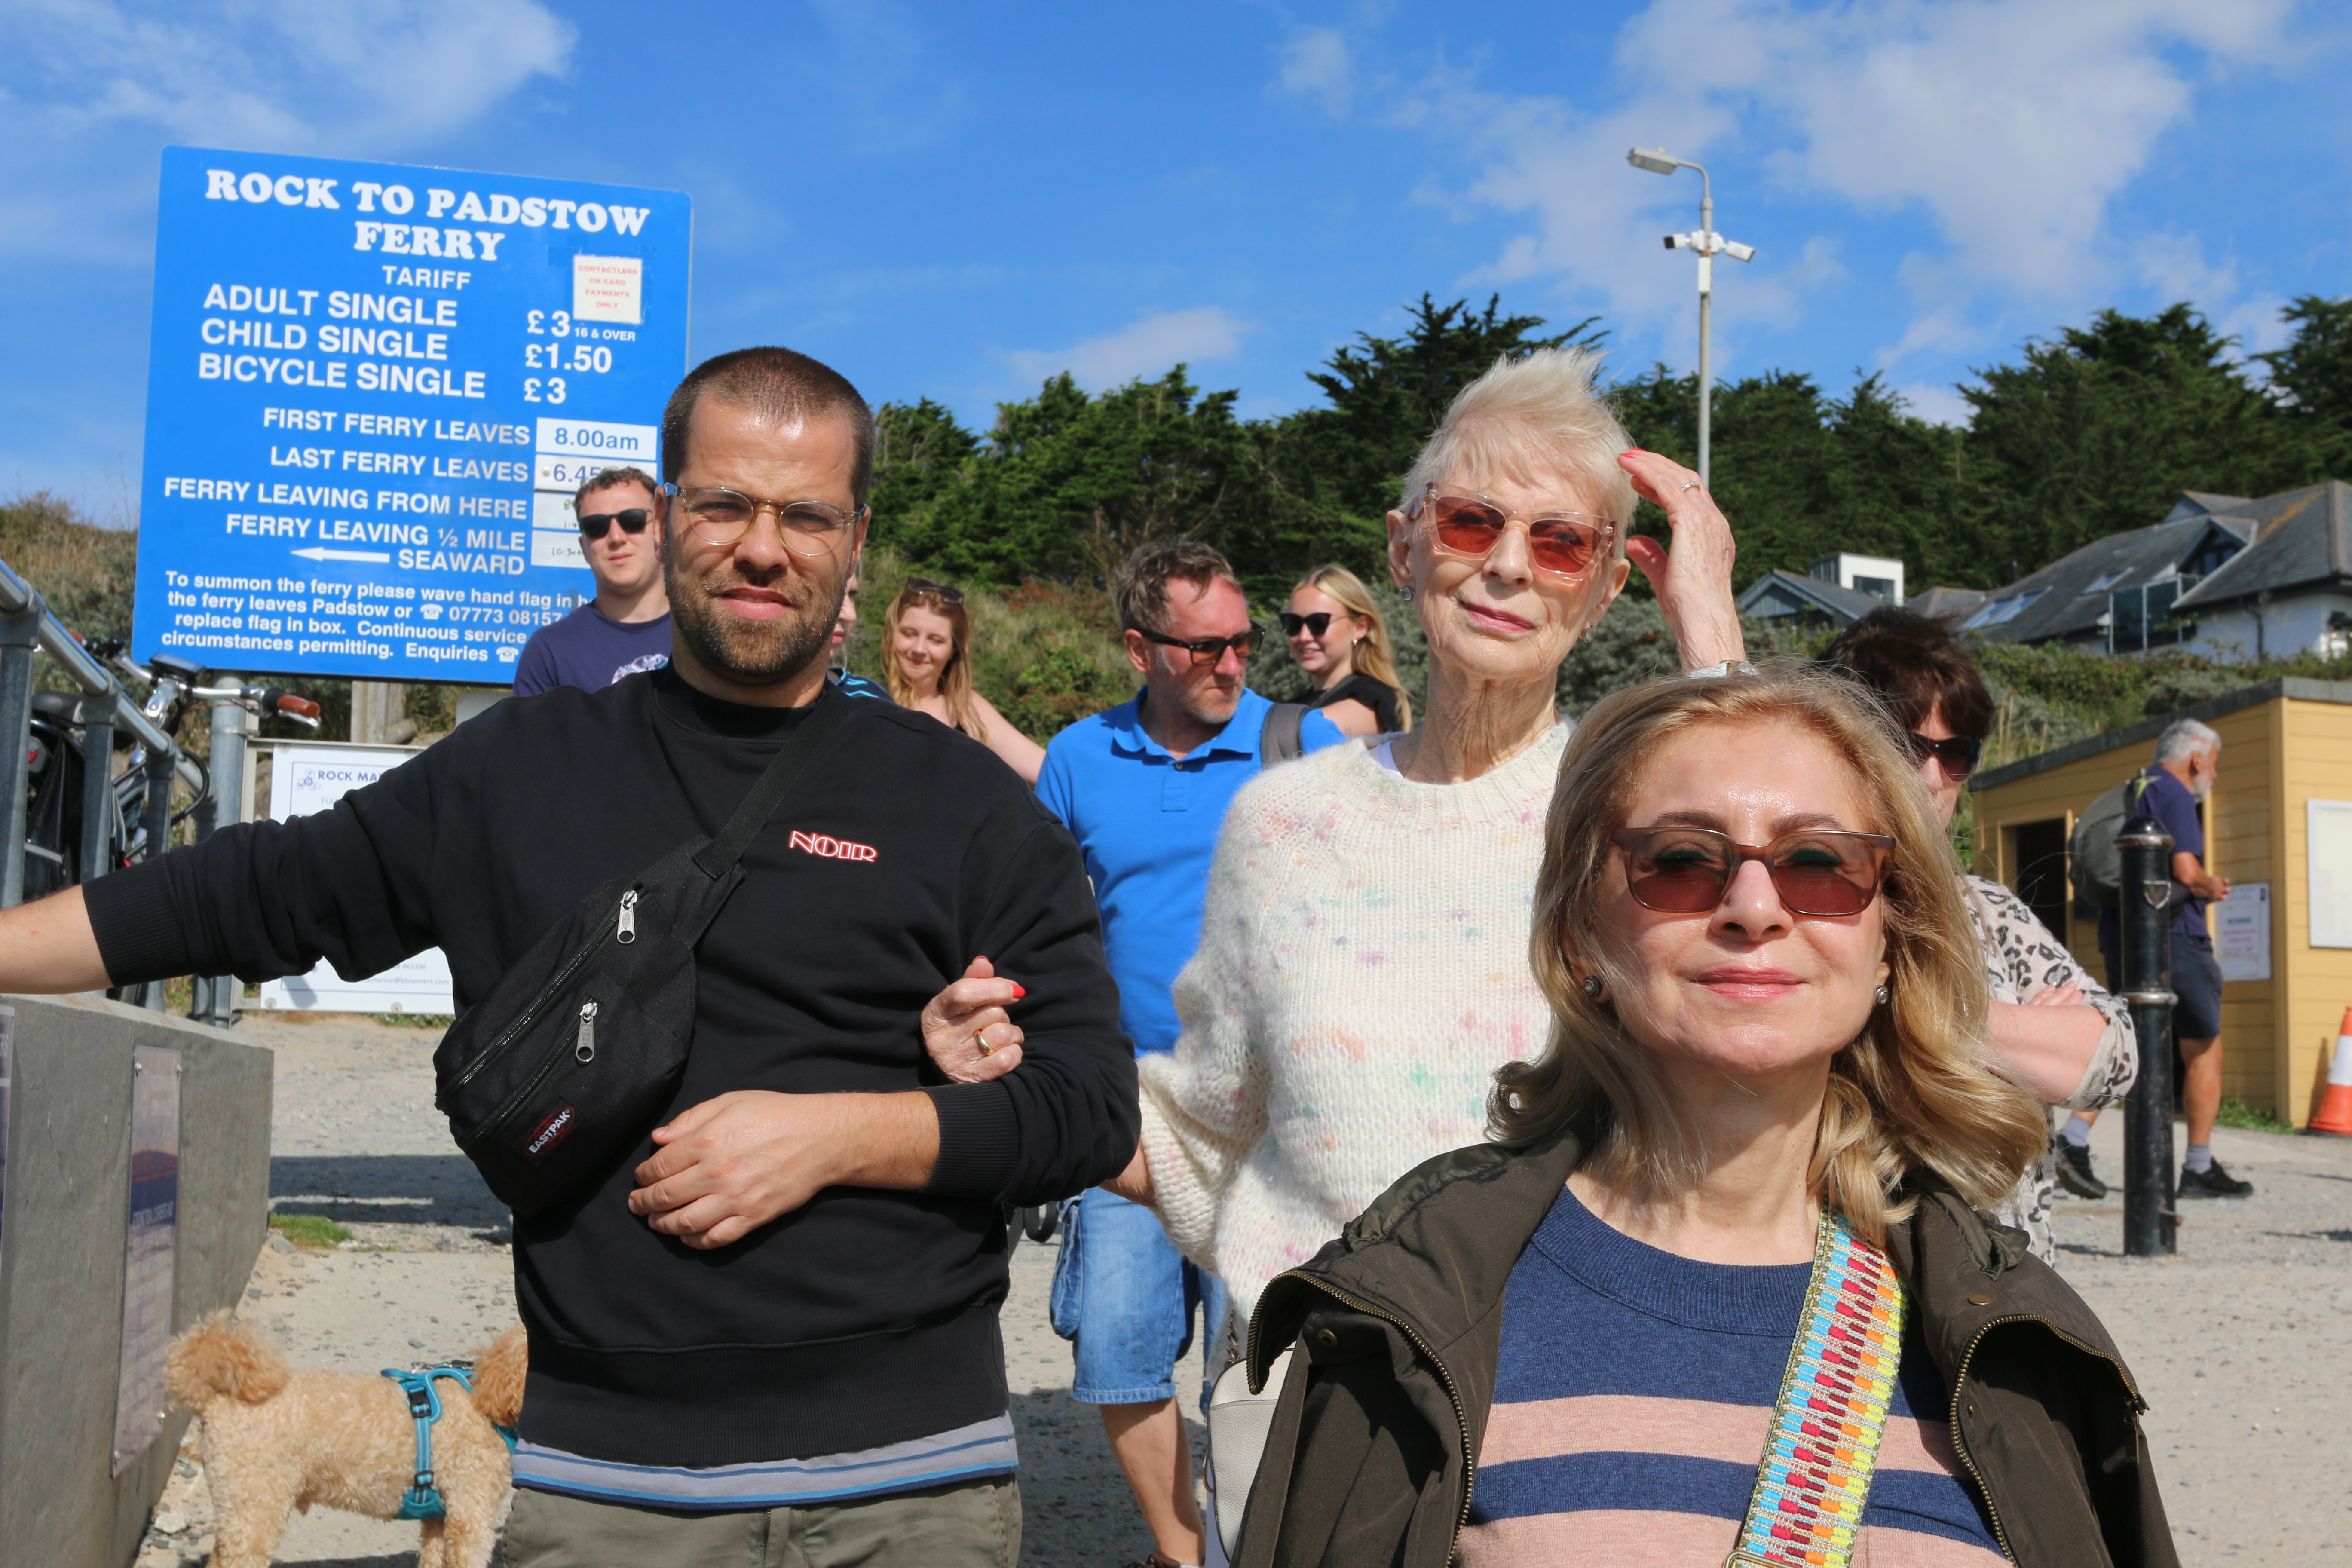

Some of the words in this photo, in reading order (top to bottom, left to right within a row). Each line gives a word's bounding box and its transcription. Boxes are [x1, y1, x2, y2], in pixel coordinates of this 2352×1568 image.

[205, 169, 340, 209] ROCK
[352, 181, 415, 215] TO
[426, 189, 650, 236] PADSTOW
[353, 220, 505, 262] FERRY
[382, 265, 471, 290] TARIFF
[579, 266, 637, 274] CONTACTLESS
[203, 283, 319, 316] ADULT
[328, 291, 457, 327] SINGLE
[585, 289, 630, 297] PAYMENTS
[201, 318, 307, 350] CHILD
[318, 325, 448, 361] SINGLE
[525, 343, 612, 374] £1.50
[574, 327, 588, 338] 16
[591, 328, 600, 339] &
[603, 329, 636, 342] OVER
[199, 352, 347, 388] BICYCLE
[356, 362, 486, 398] SINGLE
[263, 407, 338, 431] FIRST
[344, 413, 428, 438] FERRY
[435, 420, 530, 445] LEAVES
[555, 427, 638, 450] 8.00am
[270, 446, 336, 469] LAST
[342, 450, 426, 475] FERRY
[433, 457, 528, 482] LEAVES
[165, 477, 251, 502] FERRY
[258, 483, 368, 509] LEAVING
[377, 490, 450, 514] FROM
[459, 496, 527, 520] HERE
[226, 513, 312, 538] FERRY
[319, 519, 429, 545] LEAVING
[466, 529, 526, 551] MILE
[398, 548, 524, 575] SEAWARD
[165, 570, 189, 587] To
[194, 575, 272, 591] summon
[277, 577, 306, 593] the
[310, 578, 353, 599] ferry
[357, 582, 416, 600] please
[420, 588, 466, 602] wave
[471, 588, 514, 605] hand
[519, 591, 551, 611] flag
[557, 593, 572, 608] in
[168, 591, 197, 607] the
[202, 592, 245, 613] ferry
[249, 595, 307, 613] leaves
[312, 598, 389, 617] Padstow
[394, 606, 413, 618] or
[449, 606, 504, 624] 07773
[162, 630, 294, 651] circumstances
[299, 639, 394, 660] permitting.
[405, 642, 489, 662] Enquiries
[175, 612, 243, 631] replace
[248, 614, 282, 635] flag
[287, 616, 303, 632] in
[309, 618, 346, 634] box.
[357, 620, 459, 640] Continuous
[464, 628, 527, 644] service
[318, 771, 352, 781] ROCK
[790, 830, 876, 862] NOIR
[528, 1111, 571, 1153] EASTPAK
